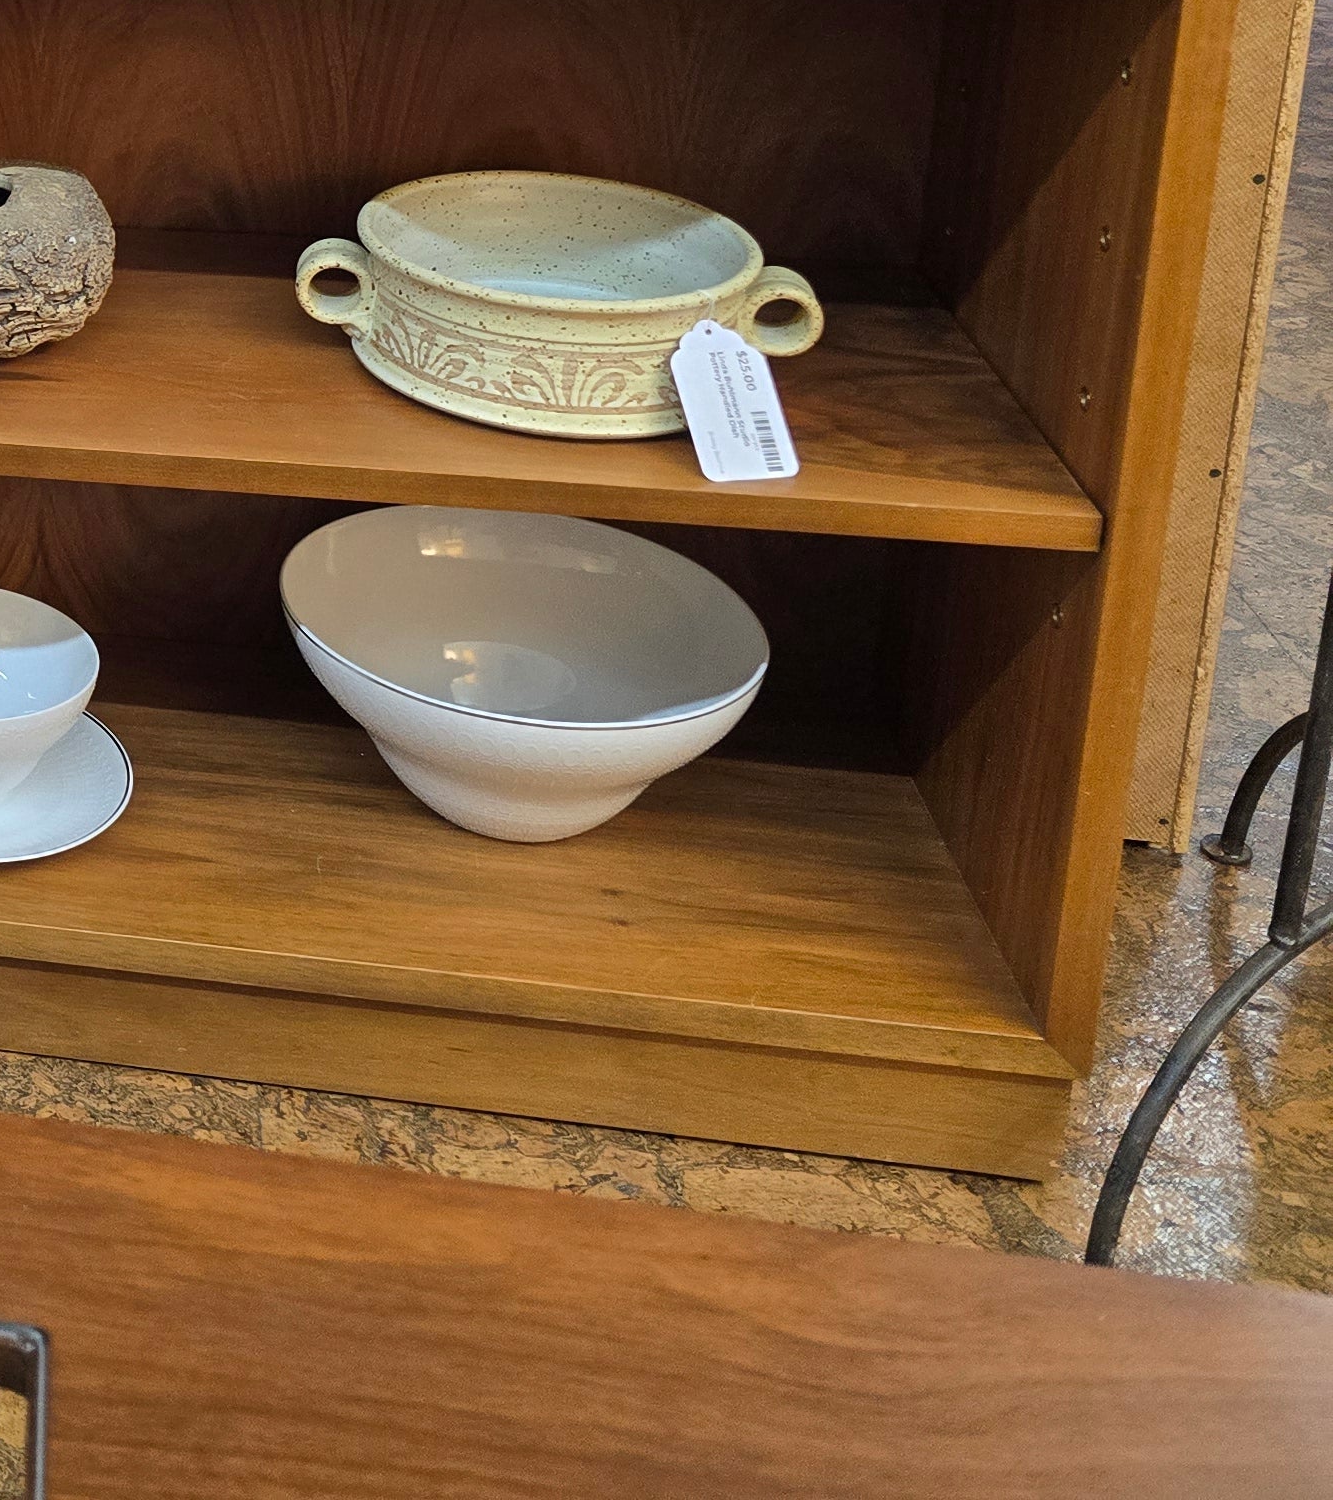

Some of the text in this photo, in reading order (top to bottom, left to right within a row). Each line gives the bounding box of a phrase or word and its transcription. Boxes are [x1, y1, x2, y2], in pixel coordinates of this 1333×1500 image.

[706, 351, 740, 439] Pottery Handled Dish
[715, 350, 751, 447] Linda Buhlmann Studio
[734, 349, 758, 392] $25.00
